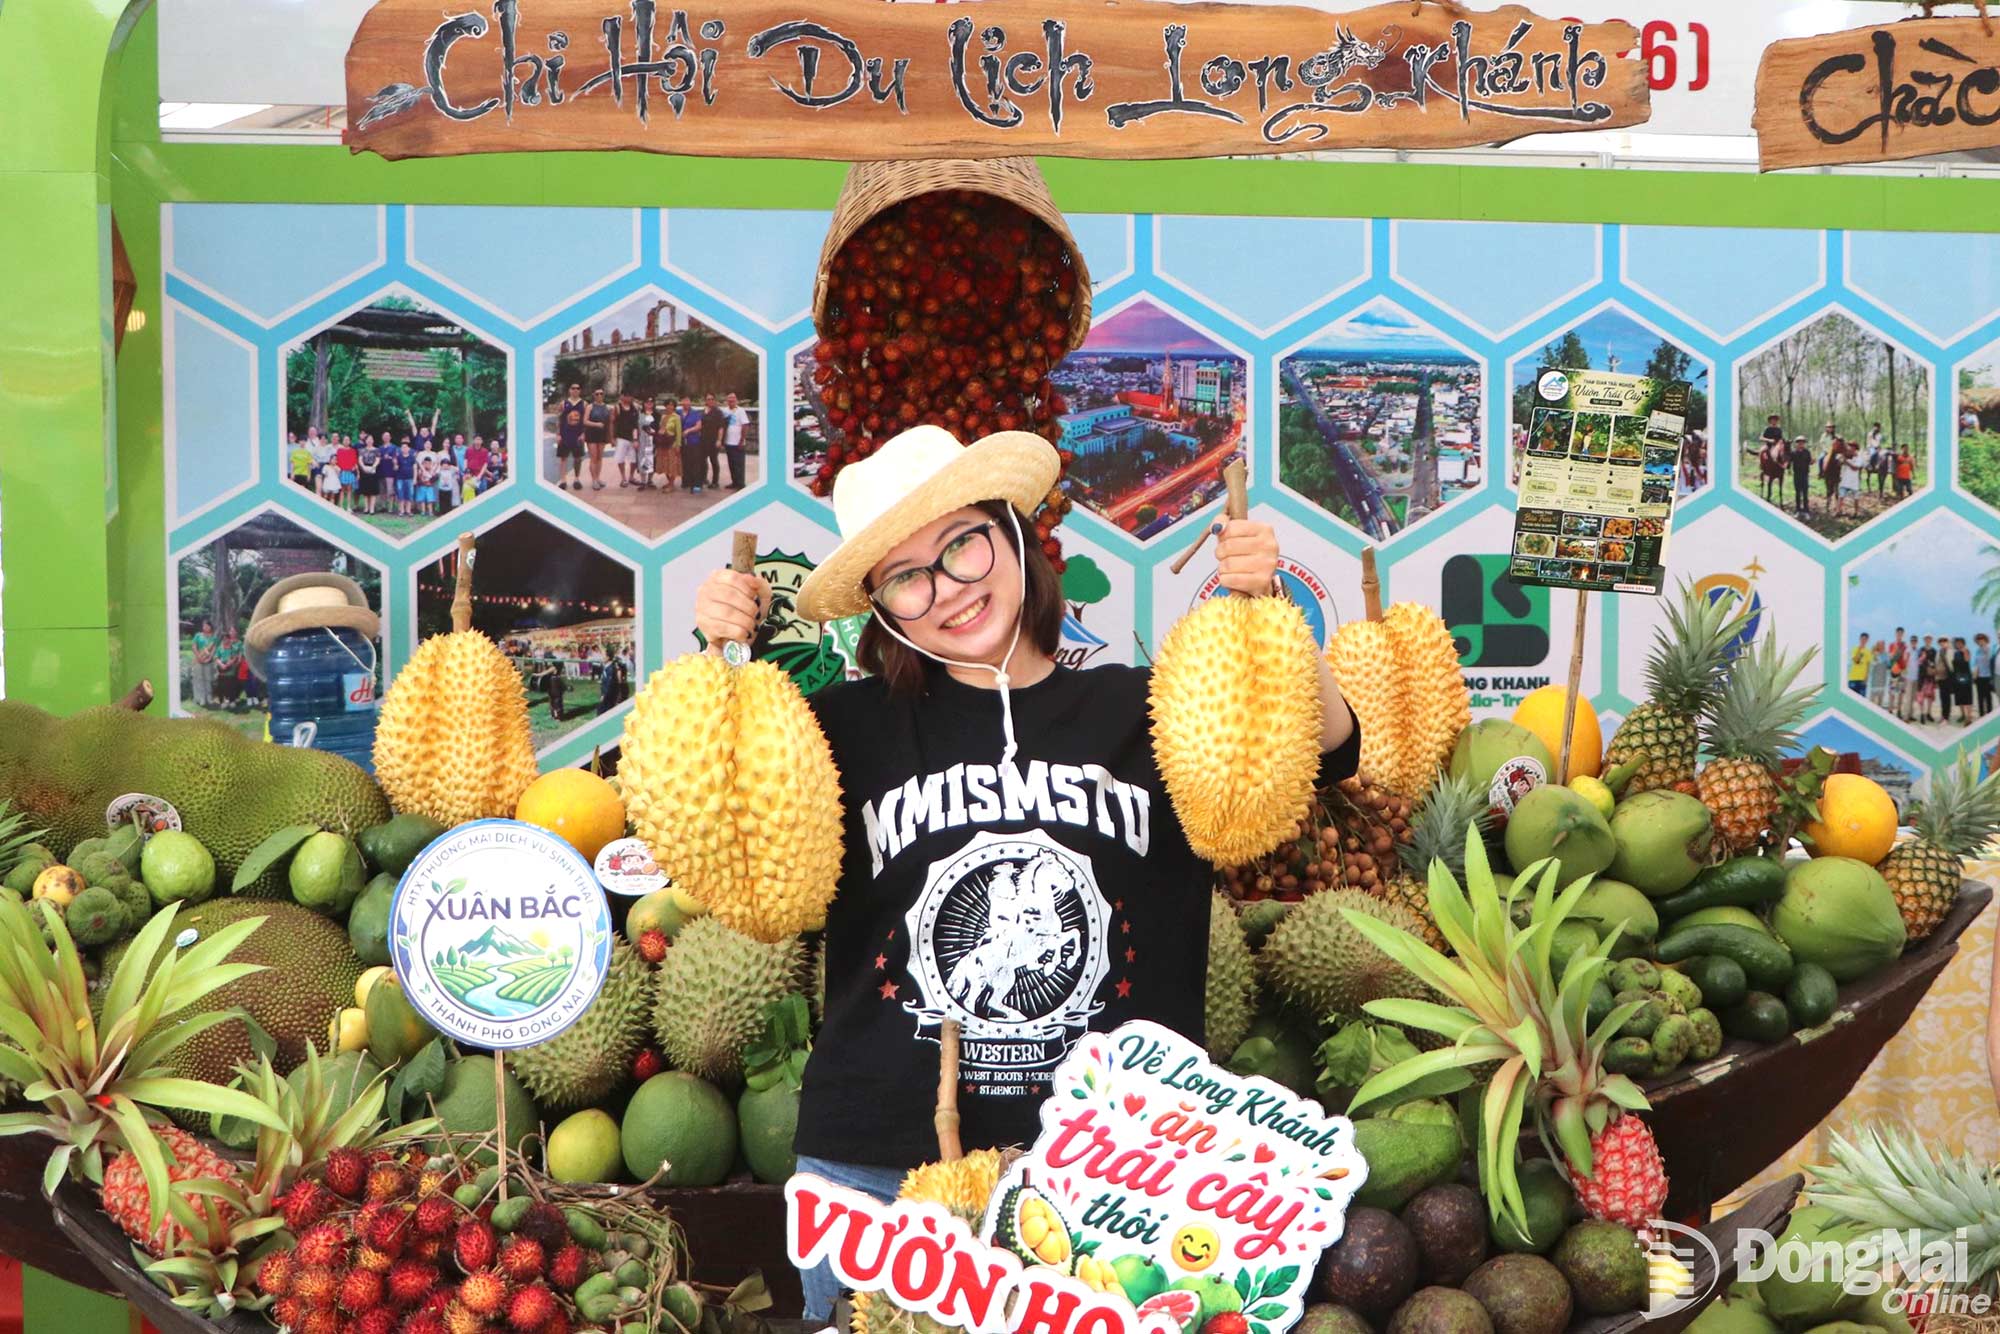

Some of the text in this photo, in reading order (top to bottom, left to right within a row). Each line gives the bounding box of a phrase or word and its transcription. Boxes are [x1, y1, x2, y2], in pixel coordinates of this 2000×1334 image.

[423, 0, 568, 127] Chi
[569, 0, 726, 130] Hội
[745, 18, 910, 117] Du
[948, 16, 1093, 135] Lịch
[1106, 23, 1375, 143] Long
[426, 884, 582, 920] XUÂN BẮC
[562, 988, 585, 1013] NAI
[963, 1041, 1046, 1062] WESTERN
[965, 1071, 991, 1082] WEST
[994, 1071, 1023, 1082] ROOTS
[1118, 1034, 1340, 1157] Về Long Khánh
[1150, 1101, 1218, 1154] ăn
[1045, 1109, 1305, 1261] trái cây
[1081, 1192, 1170, 1245] thôi
[794, 1189, 1007, 1328] VƯỜN
